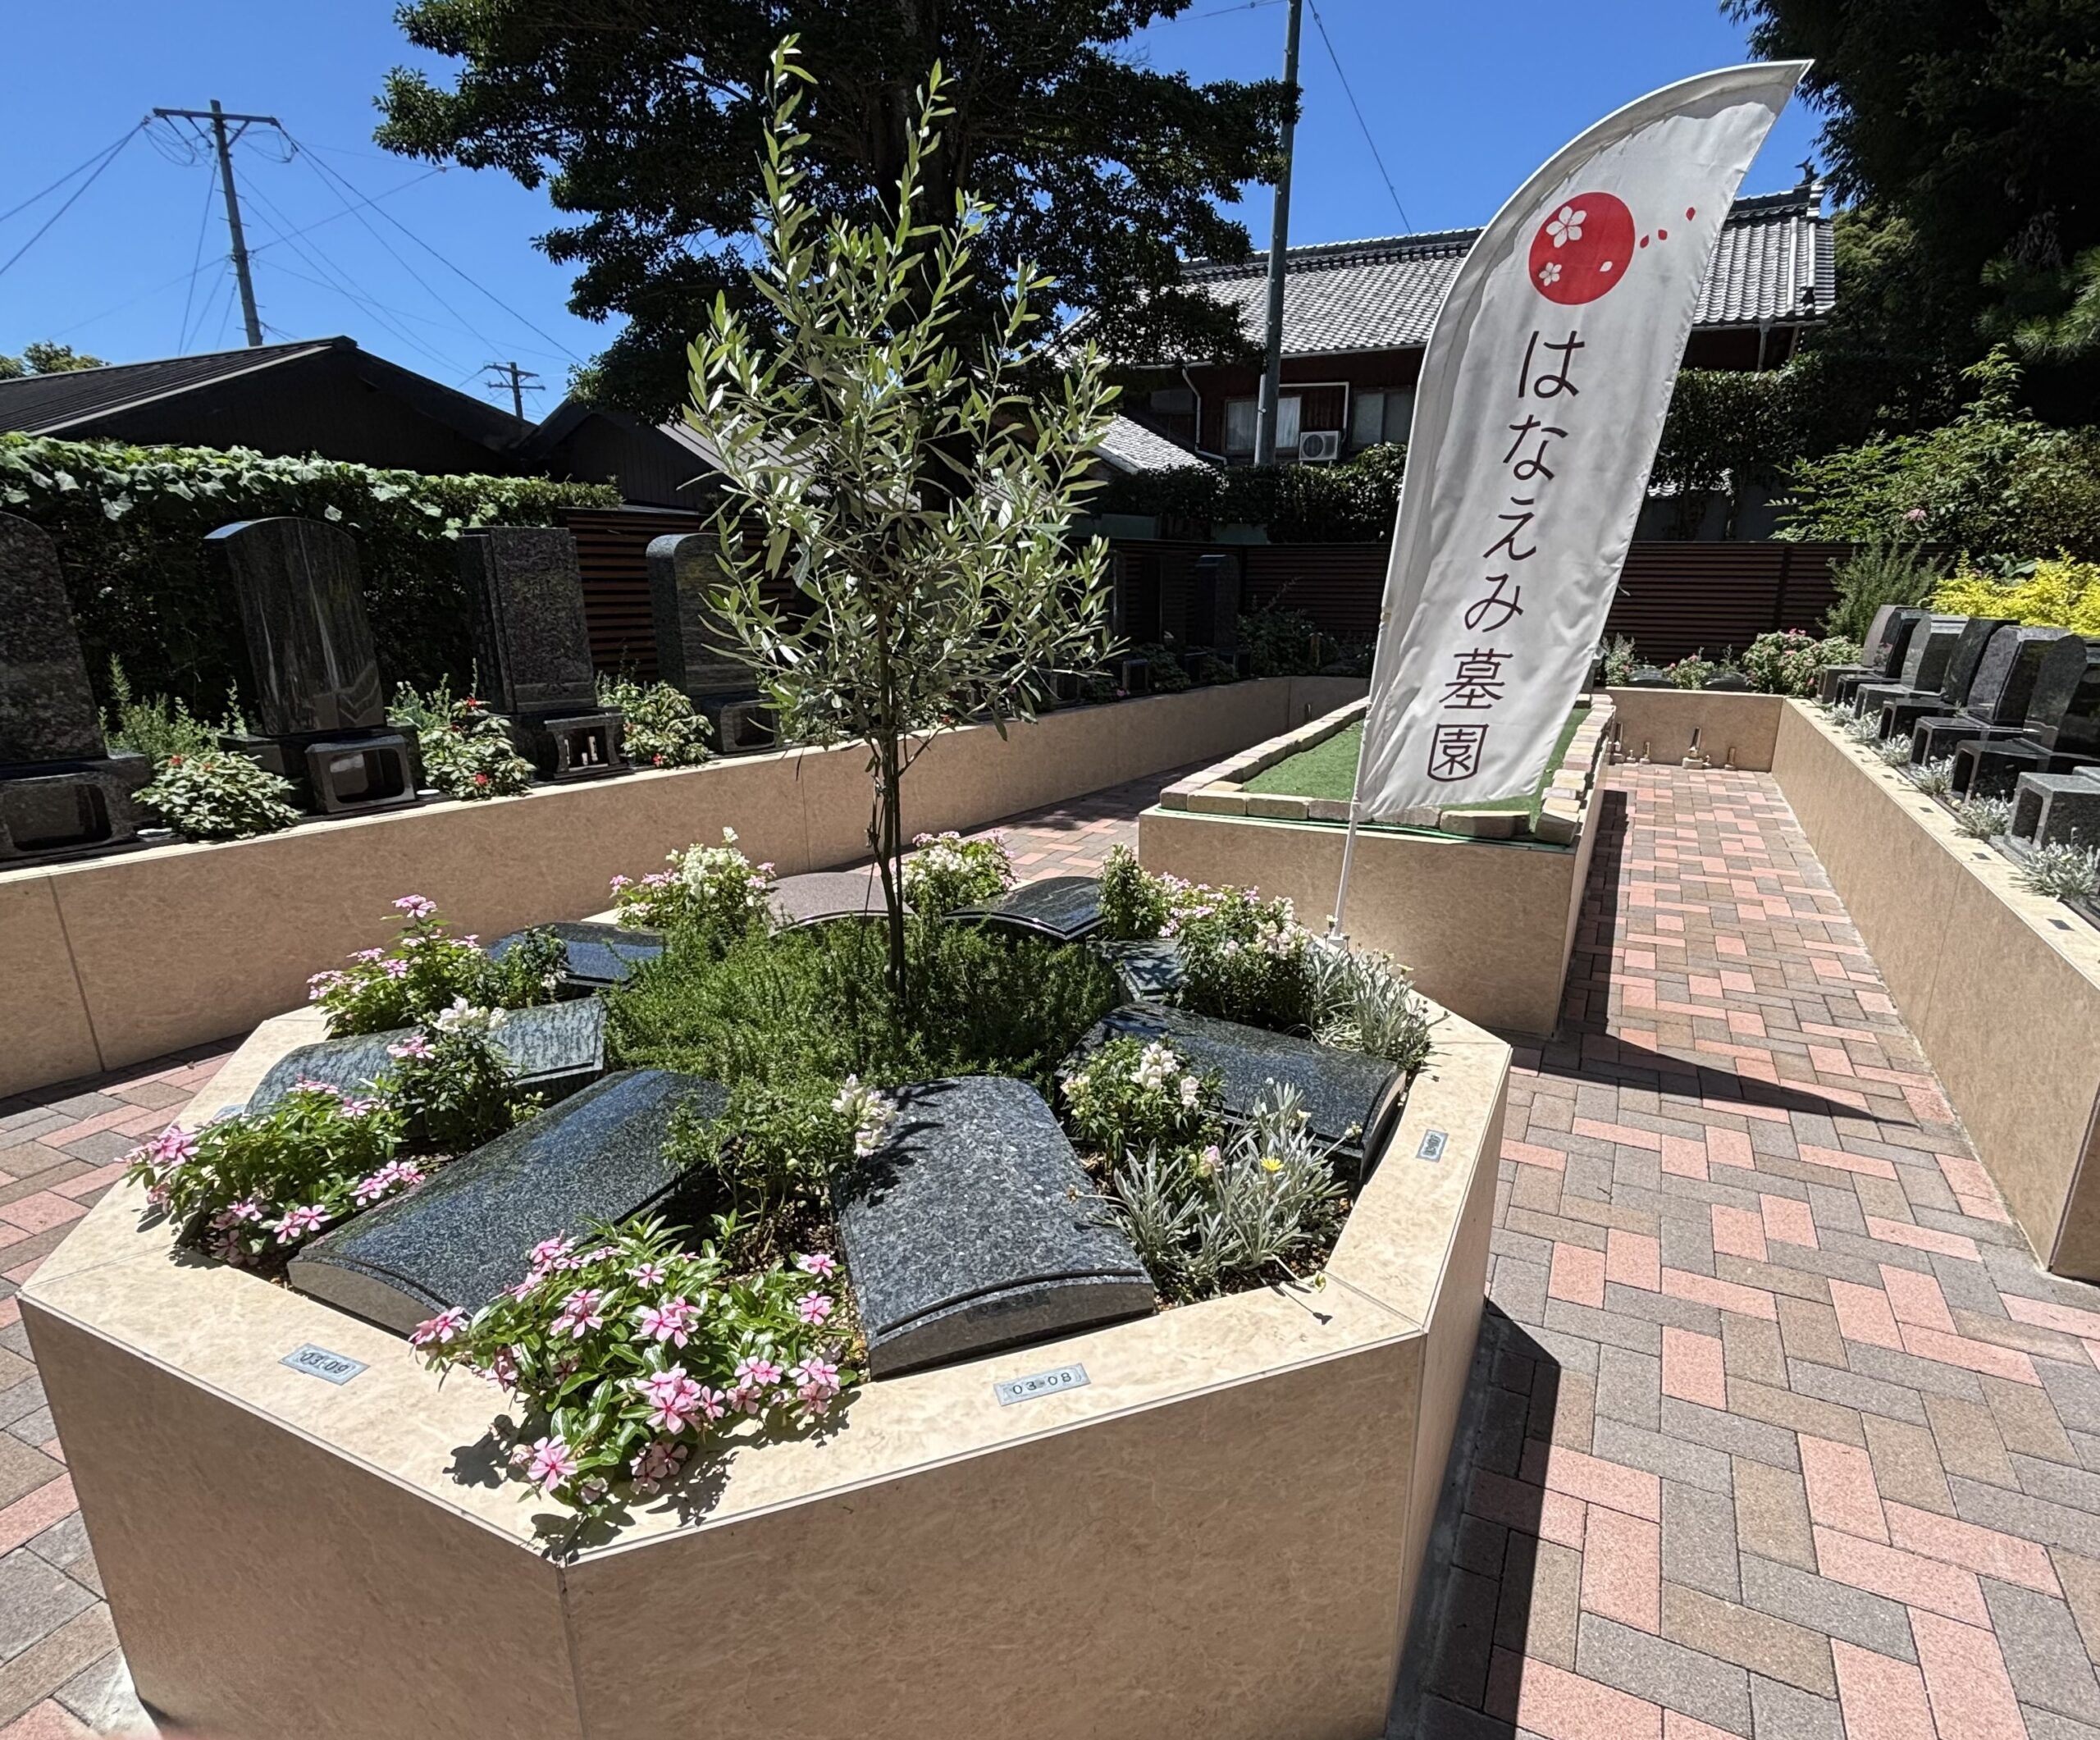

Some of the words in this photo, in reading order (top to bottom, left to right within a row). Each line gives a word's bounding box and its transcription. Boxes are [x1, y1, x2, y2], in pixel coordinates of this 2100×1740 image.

[1427, 331, 1585, 783] はなえみ墓園
[1012, 1372, 1072, 1395] 03-08
